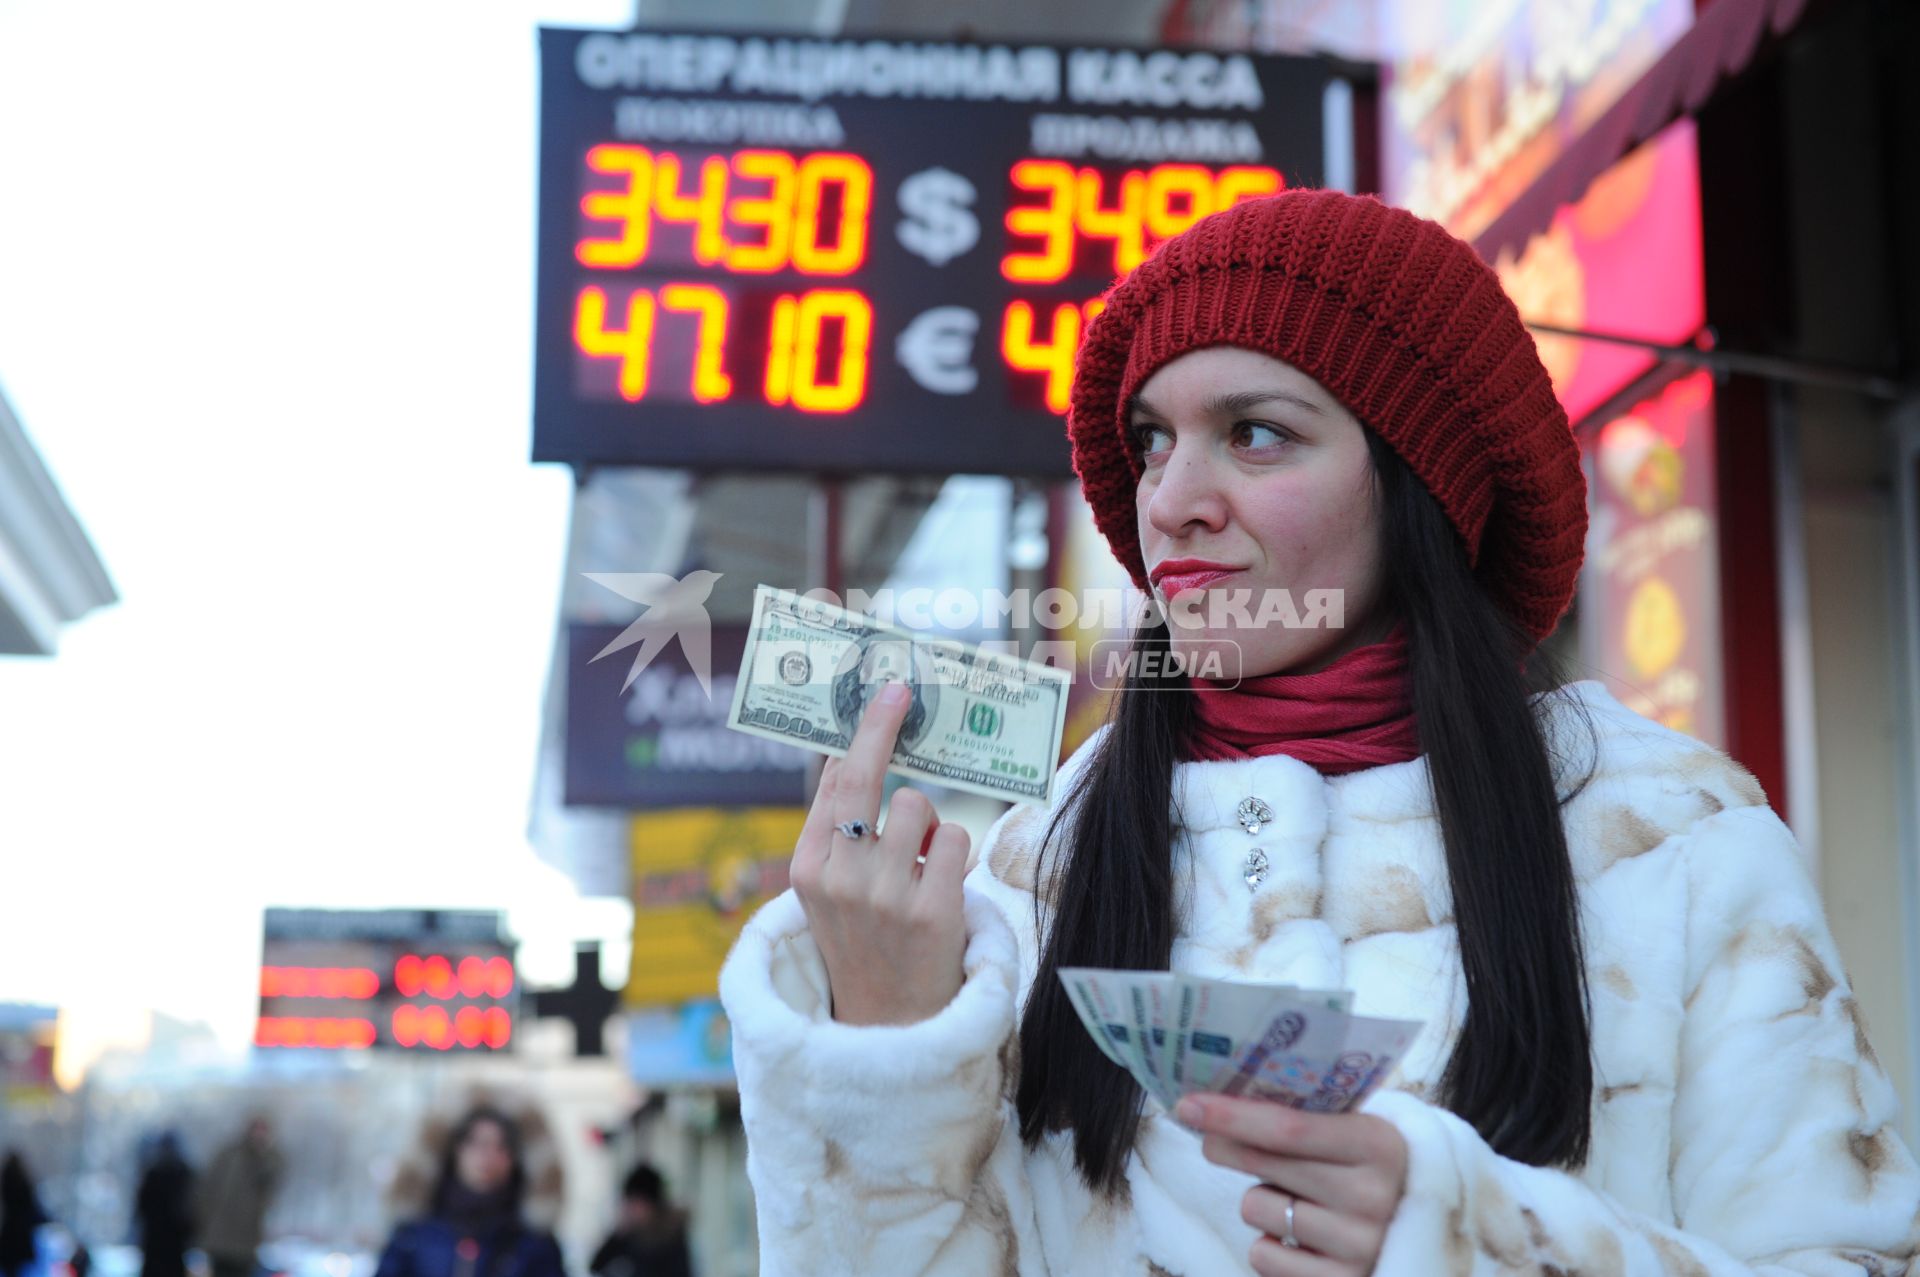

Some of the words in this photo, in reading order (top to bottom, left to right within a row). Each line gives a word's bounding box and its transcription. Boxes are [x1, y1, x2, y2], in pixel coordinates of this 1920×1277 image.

[575, 33, 1060, 101] ОПЕРАЦИОННАЯ
[1067, 48, 1263, 110] КАССА
[614, 97, 844, 146] ПОКУПКА
[1030, 112, 1263, 161] ПРОДАЖА
[1001, 299, 1106, 415] 4
[753, 708, 814, 738] 100
[990, 758, 1039, 780] 100
